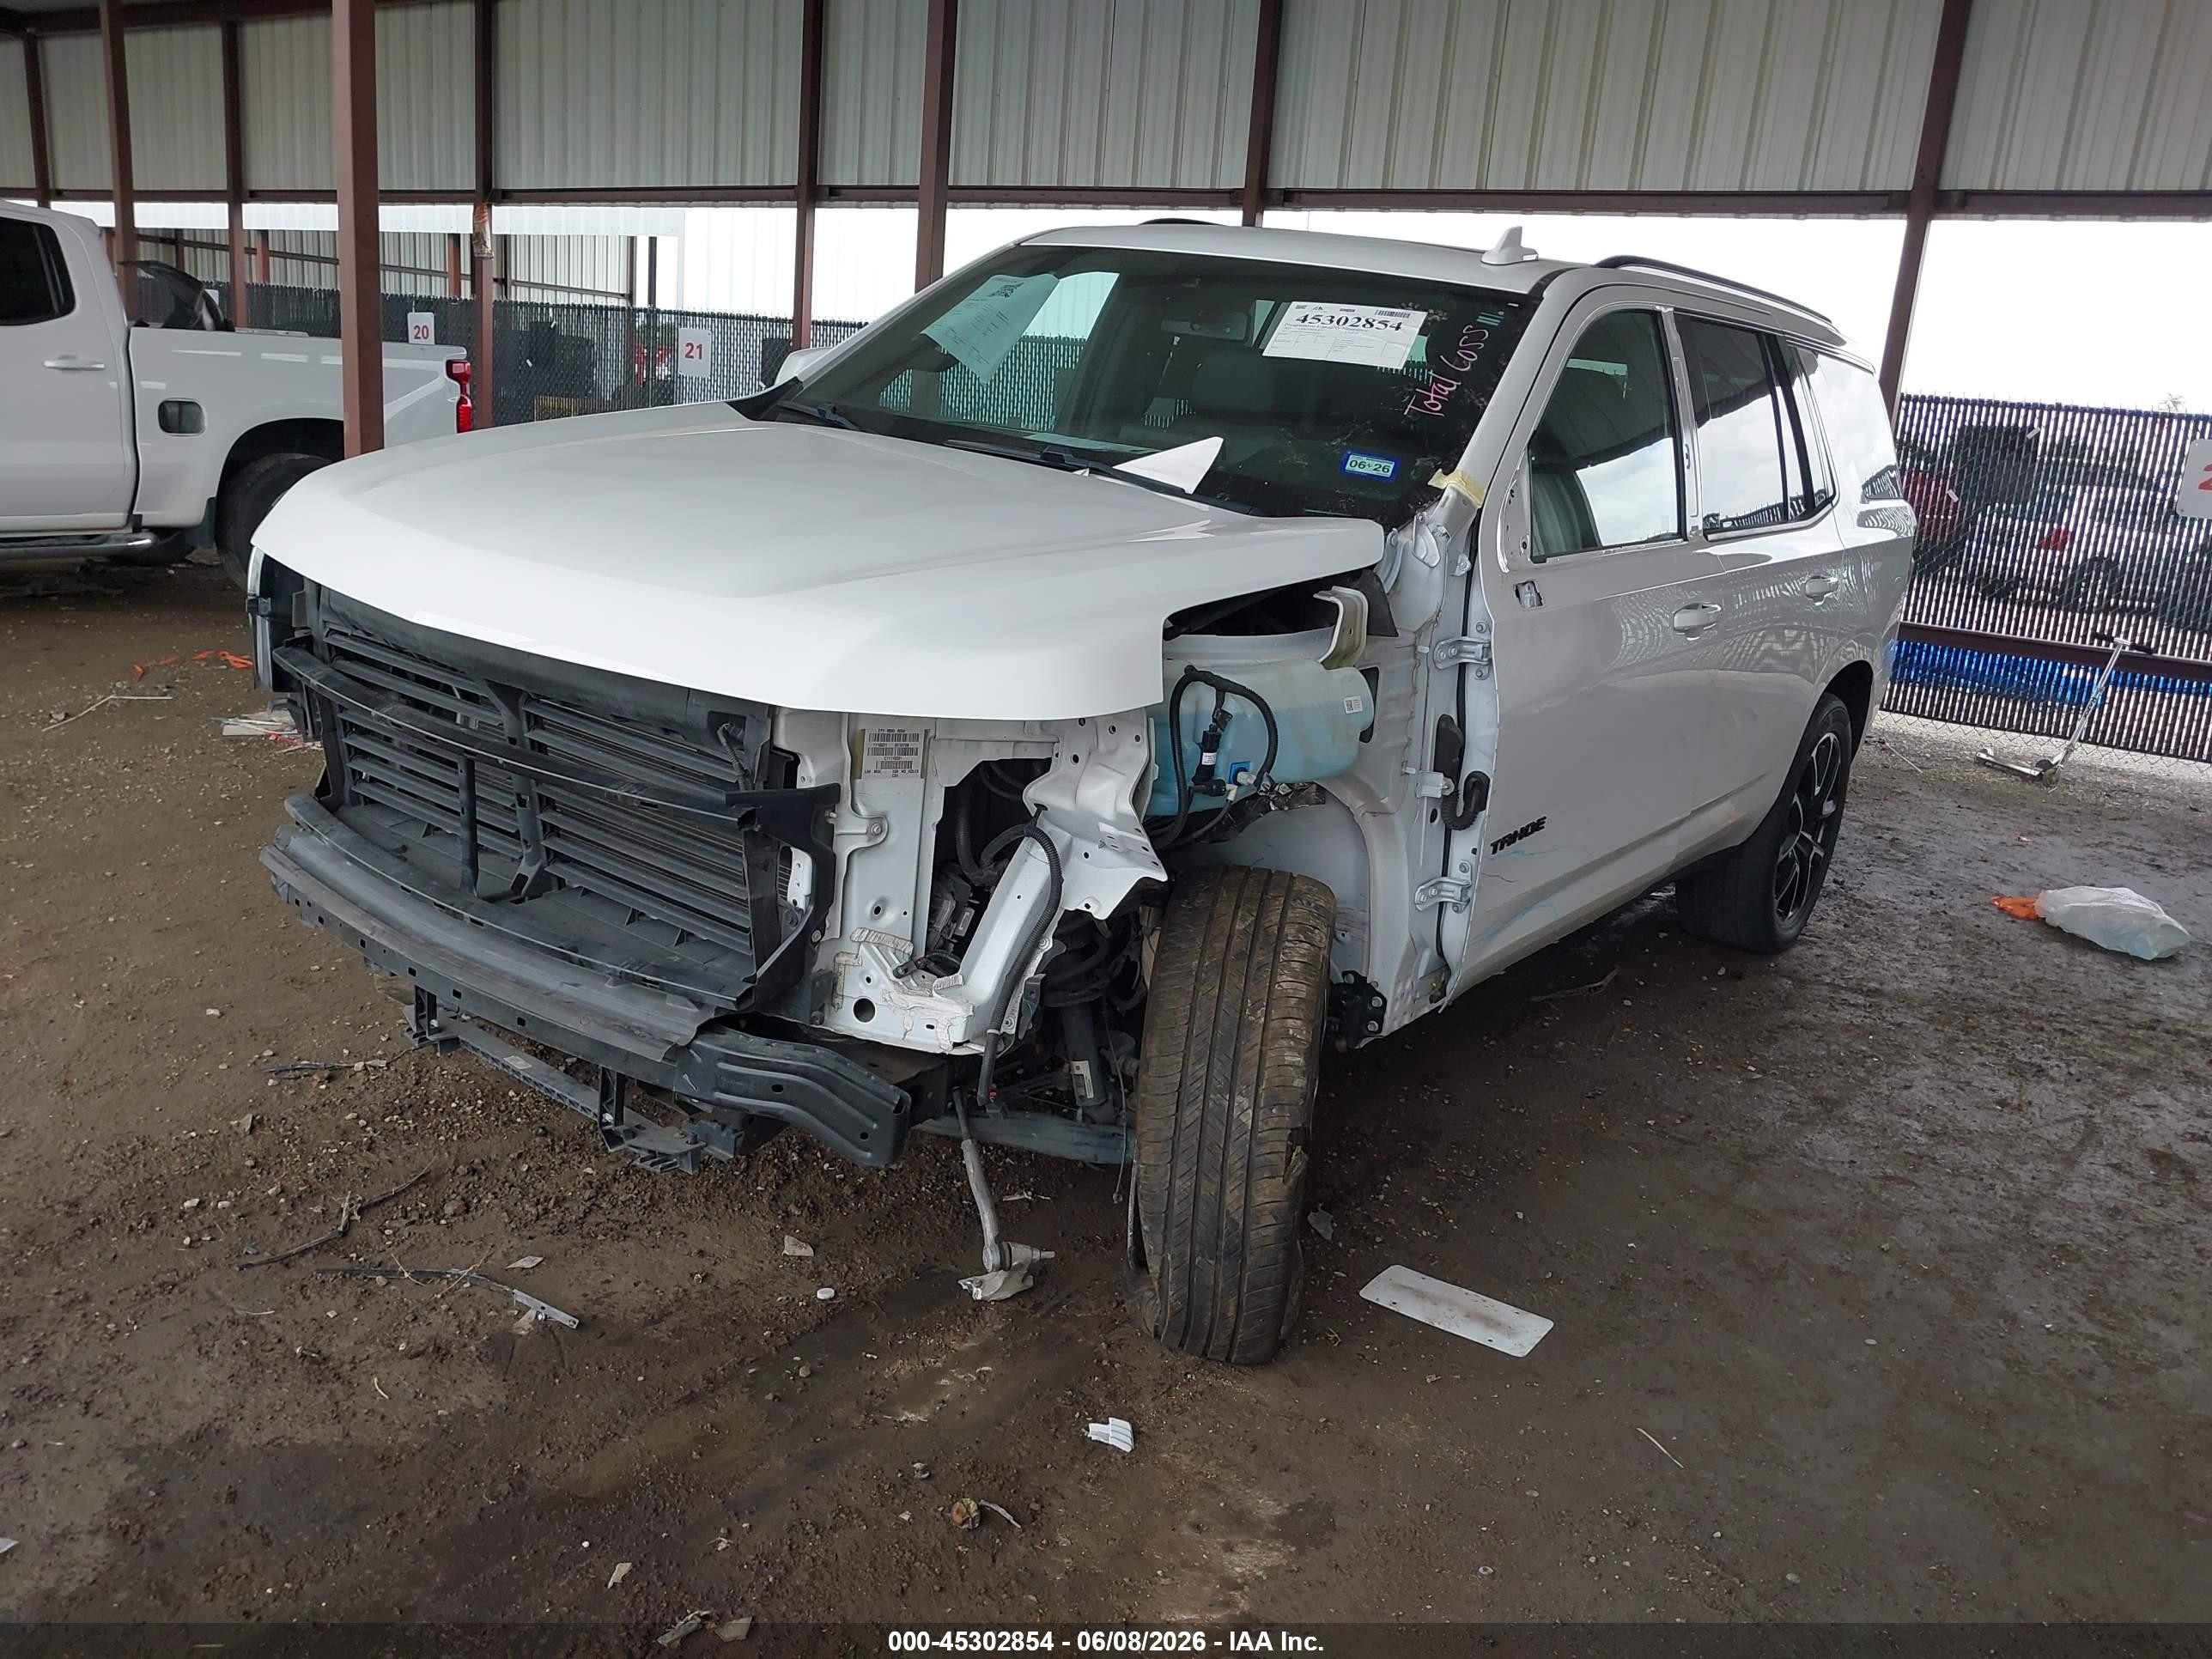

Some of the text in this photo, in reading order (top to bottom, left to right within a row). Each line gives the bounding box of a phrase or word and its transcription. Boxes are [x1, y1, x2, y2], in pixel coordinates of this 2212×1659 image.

[1295, 313, 1402, 331] 45302854
[413, 325, 429, 340] 20
[684, 342, 703, 360] 21
[1349, 459, 1390, 473] 06 26
[1490, 816, 1547, 855] TAHOE
